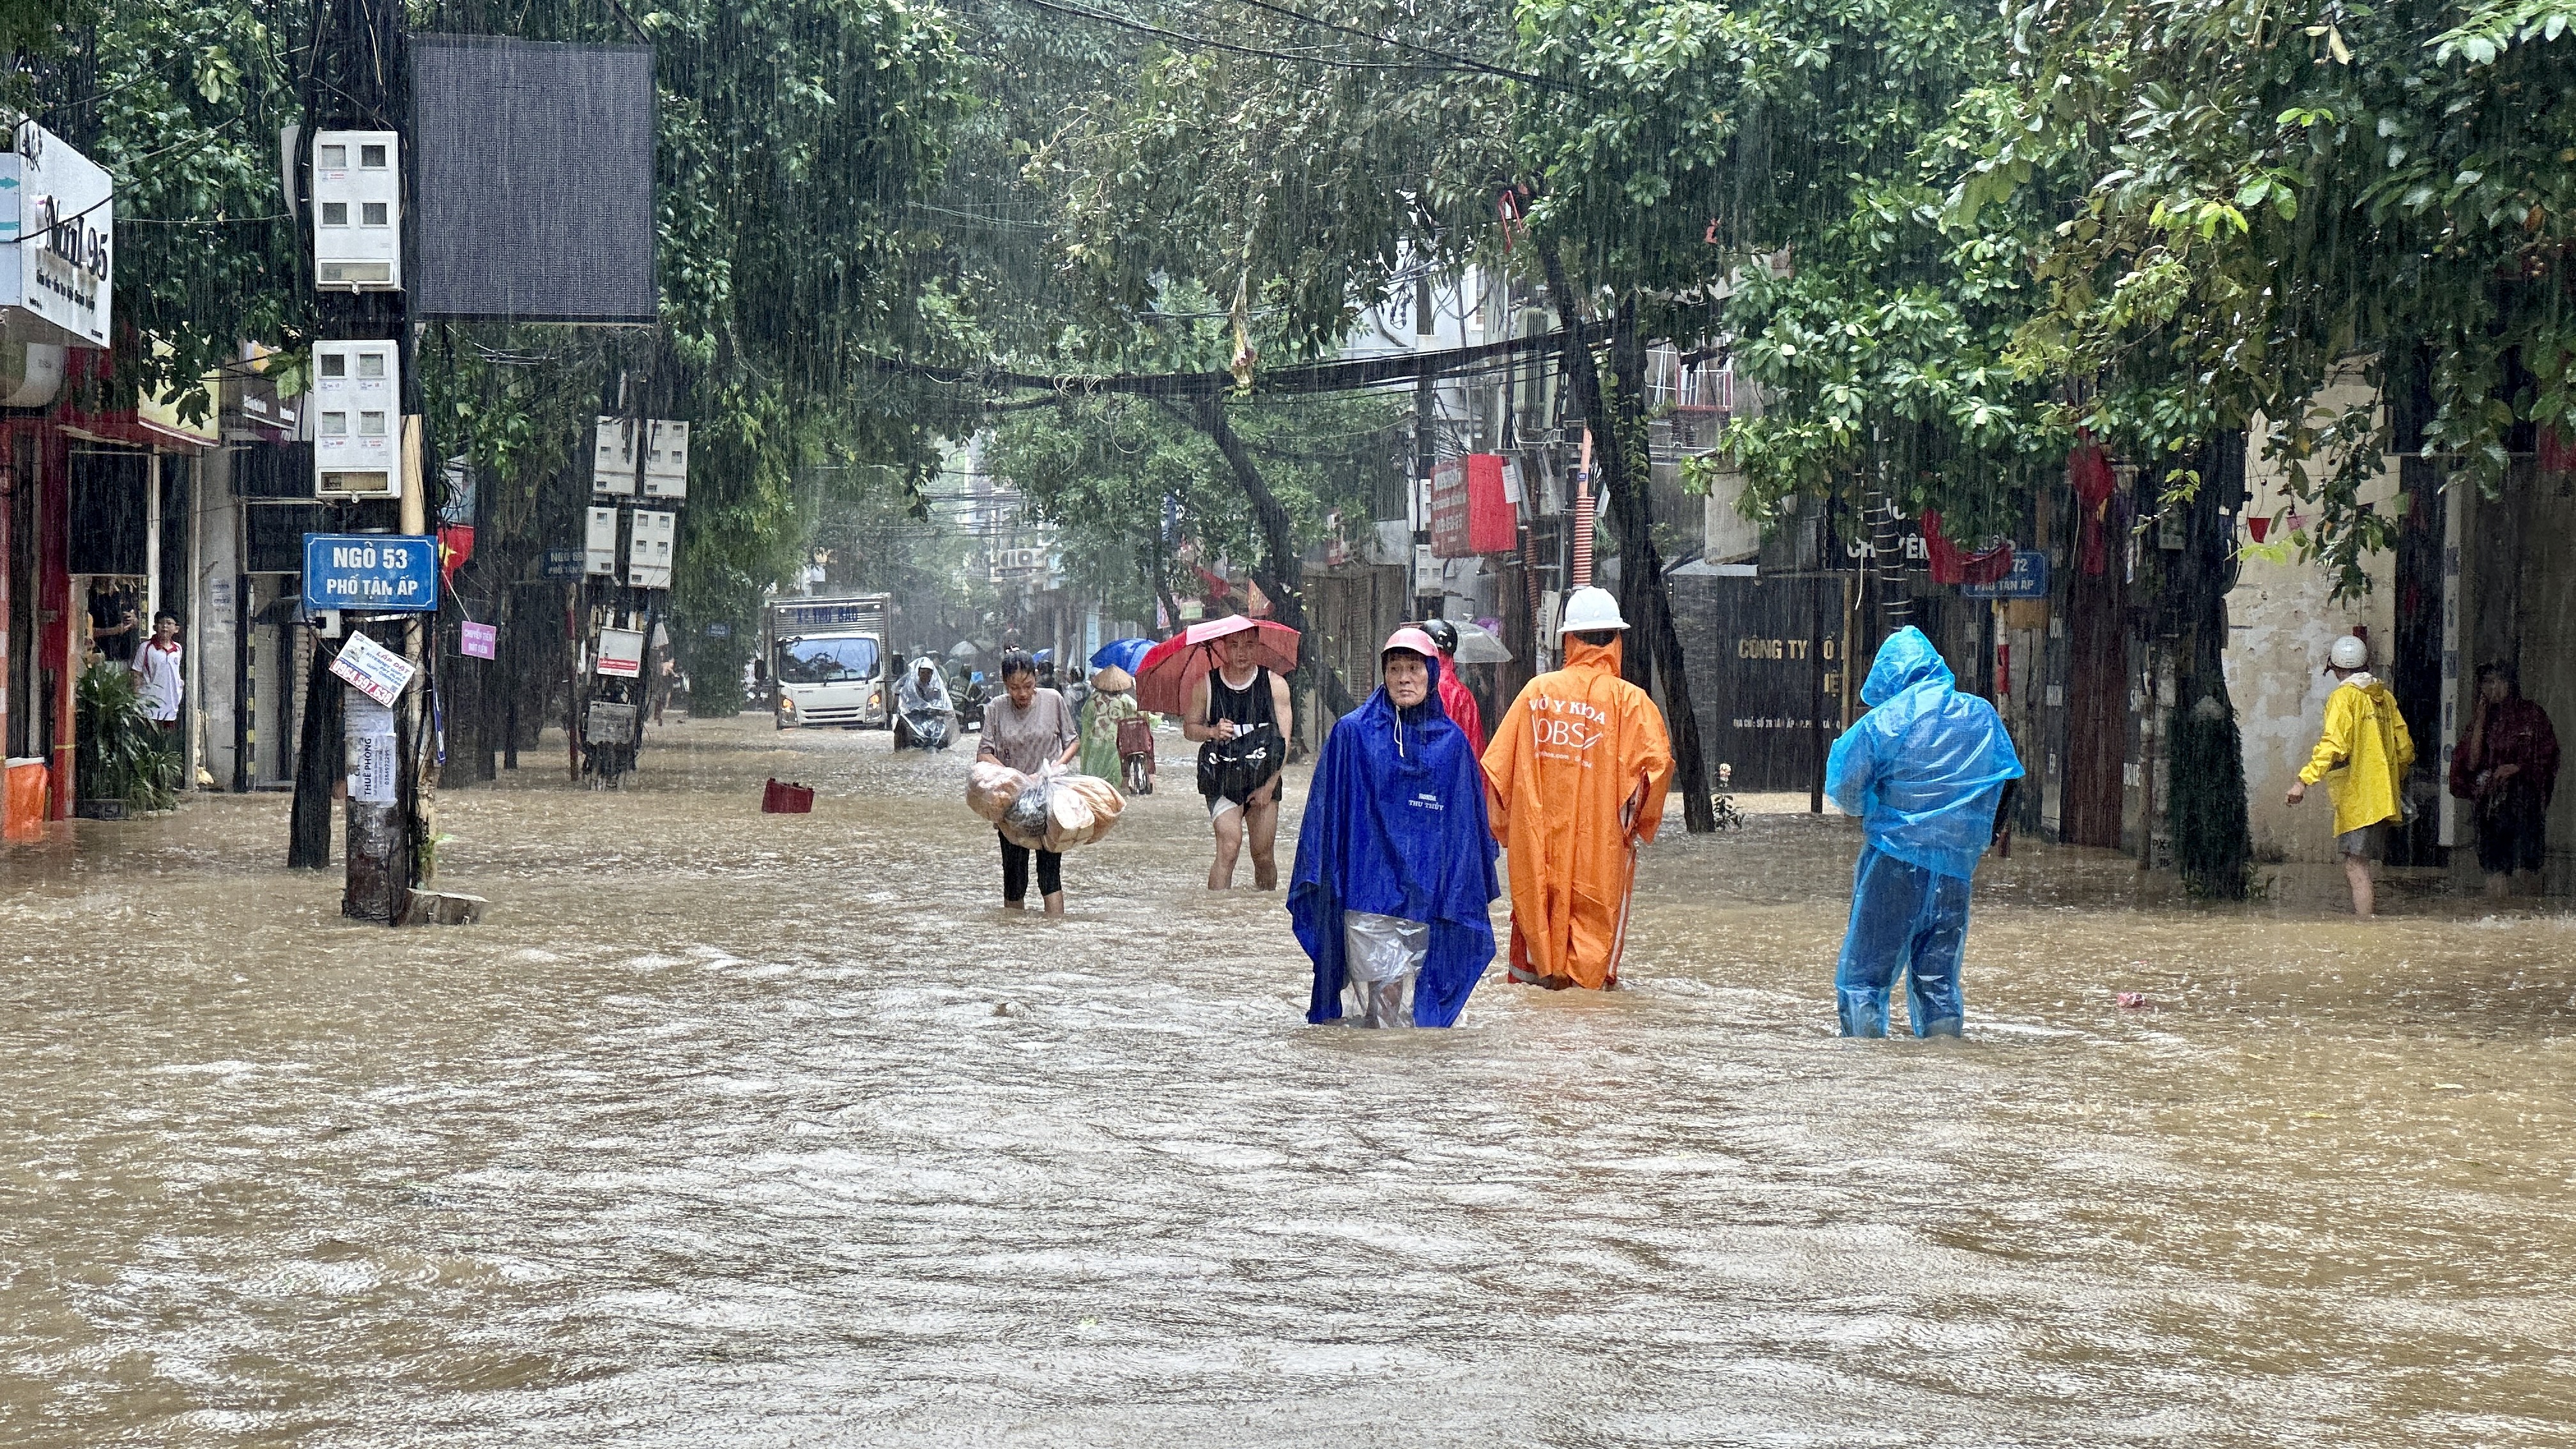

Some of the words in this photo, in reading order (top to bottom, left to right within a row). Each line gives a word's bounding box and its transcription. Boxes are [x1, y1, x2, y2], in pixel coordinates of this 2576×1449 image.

[87, 226, 108, 282] 95
[383, 548, 408, 569] 53
[572, 551, 583, 562] 69
[2012, 558, 2028, 572] 72
[326, 573, 360, 595] PHỐ
[397, 574, 418, 595] ẤP
[1738, 634, 1782, 659] CÔNG
[1788, 640, 1808, 659] TY
[332, 659, 394, 705] 0964.597.638
[1554, 700, 1567, 712] Y
[1569, 701, 1606, 725] KHOA
[363, 772, 371, 796] THUÊ
